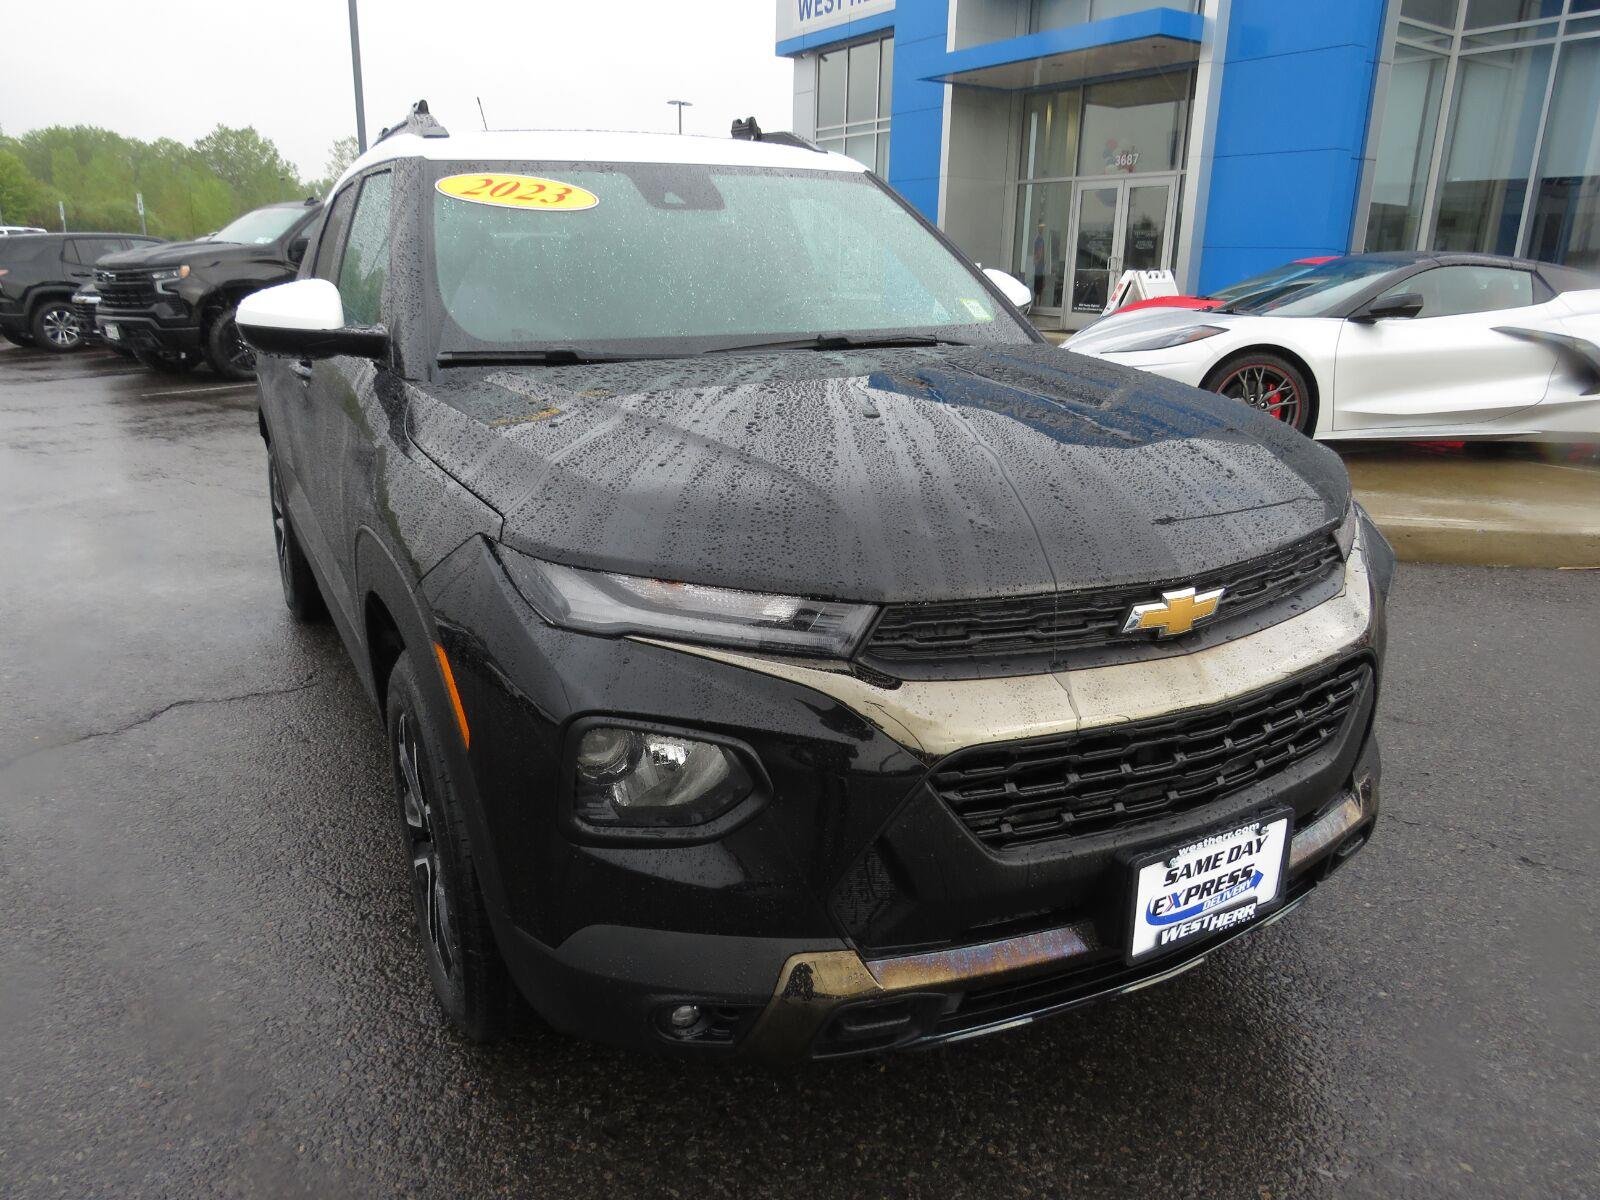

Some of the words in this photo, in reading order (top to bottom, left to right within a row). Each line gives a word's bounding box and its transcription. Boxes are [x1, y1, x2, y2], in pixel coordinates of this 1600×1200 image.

[1114, 153, 1139, 167] 3687
[461, 178, 573, 204] 2023
[1178, 822, 1260, 856] westherr.com
[1163, 851, 1225, 887] SAME
[1226, 835, 1269, 864] DAY
[1151, 863, 1255, 917] EXPRESS
[1202, 880, 1252, 911] DELIVERY
